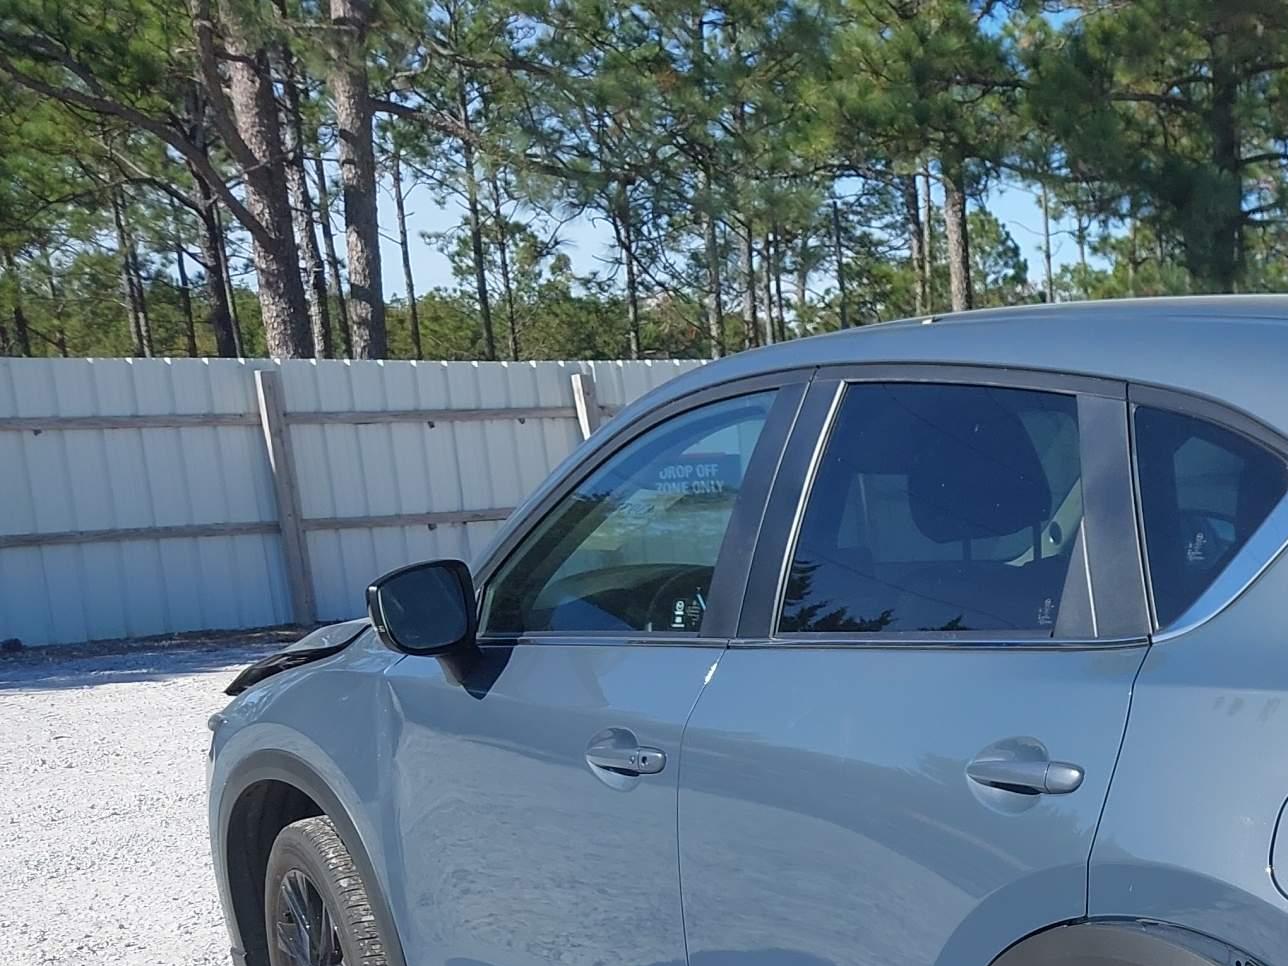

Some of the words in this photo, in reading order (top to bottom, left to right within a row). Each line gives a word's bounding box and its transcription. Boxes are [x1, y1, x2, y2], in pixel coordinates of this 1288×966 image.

[659, 465, 693, 479] DROP
[695, 464, 719, 478] OFF
[692, 480, 725, 494] ONLY
